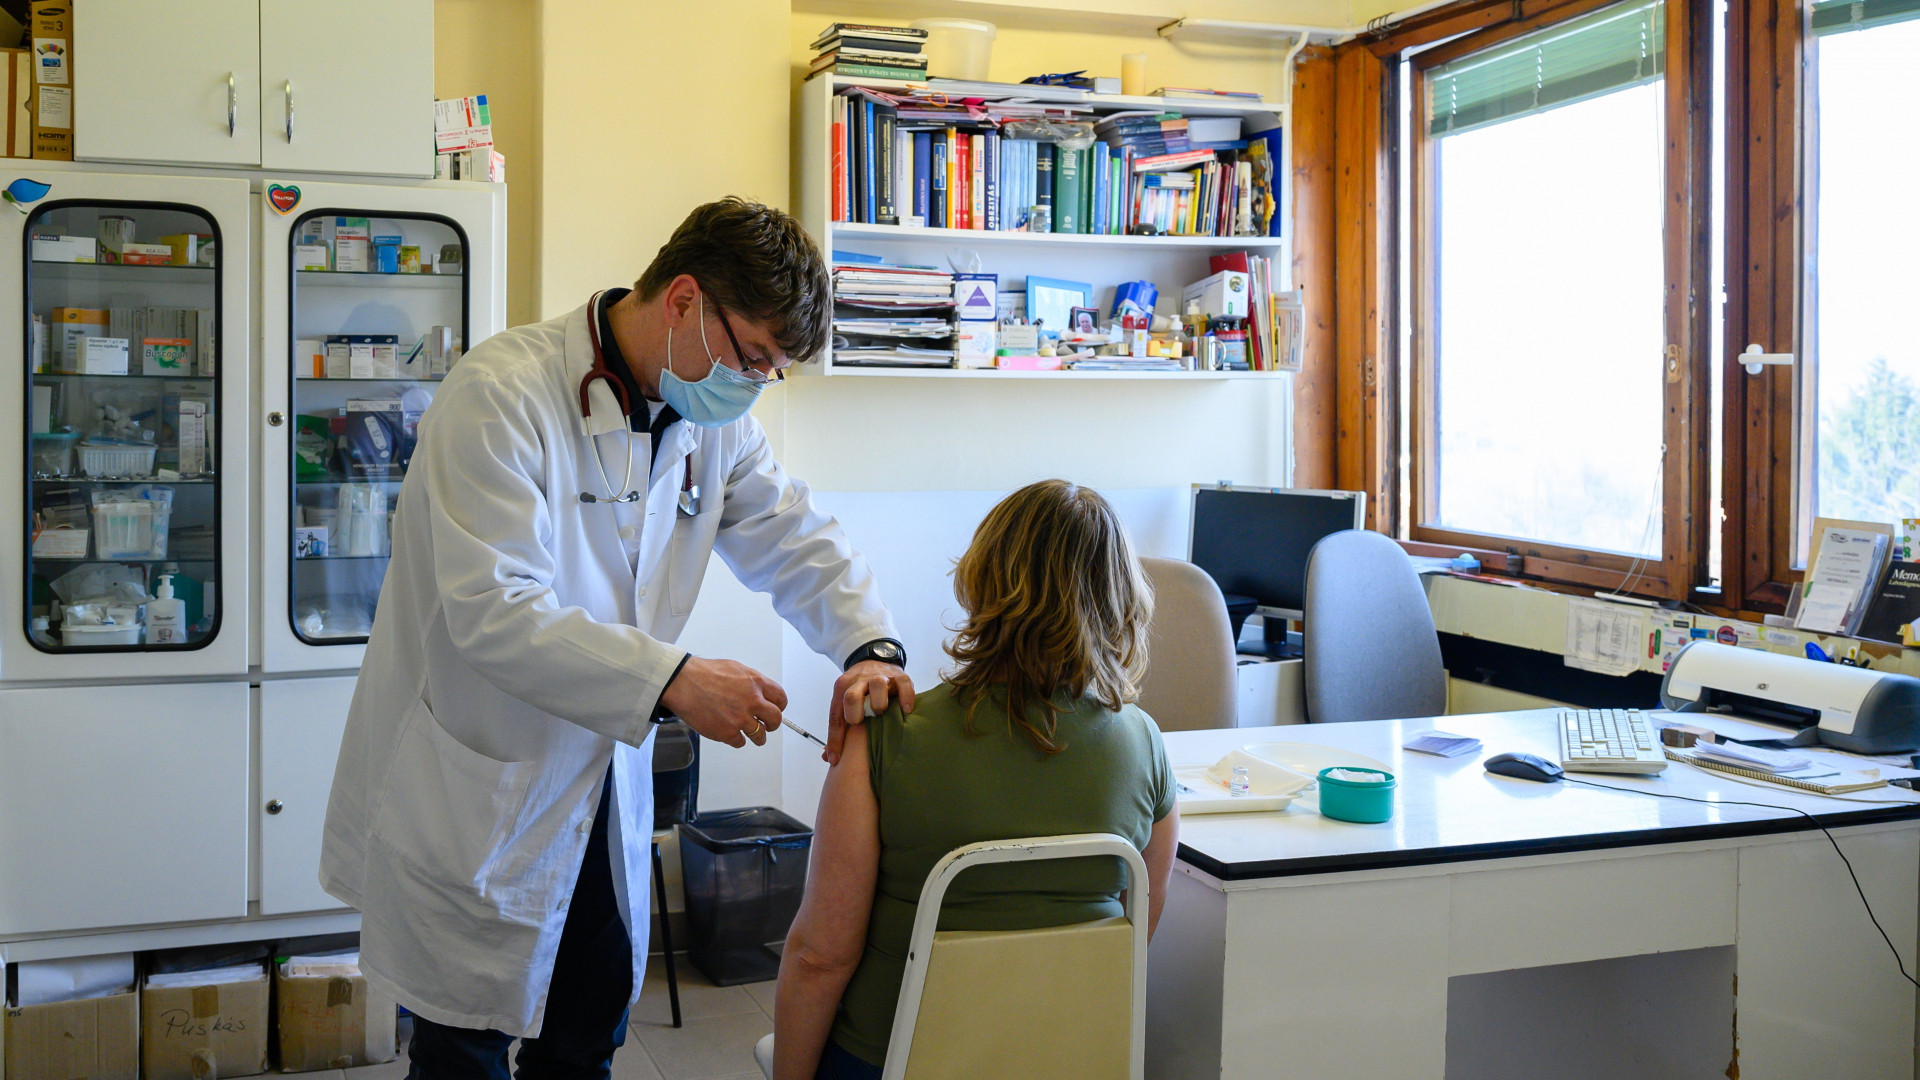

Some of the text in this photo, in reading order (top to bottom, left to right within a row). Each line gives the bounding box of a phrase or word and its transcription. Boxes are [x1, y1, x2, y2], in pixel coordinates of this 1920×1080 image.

[56, 20, 63, 31] 3
[145, 349, 188, 360] Buscopan
[160, 1008, 248, 1039] Puskás
